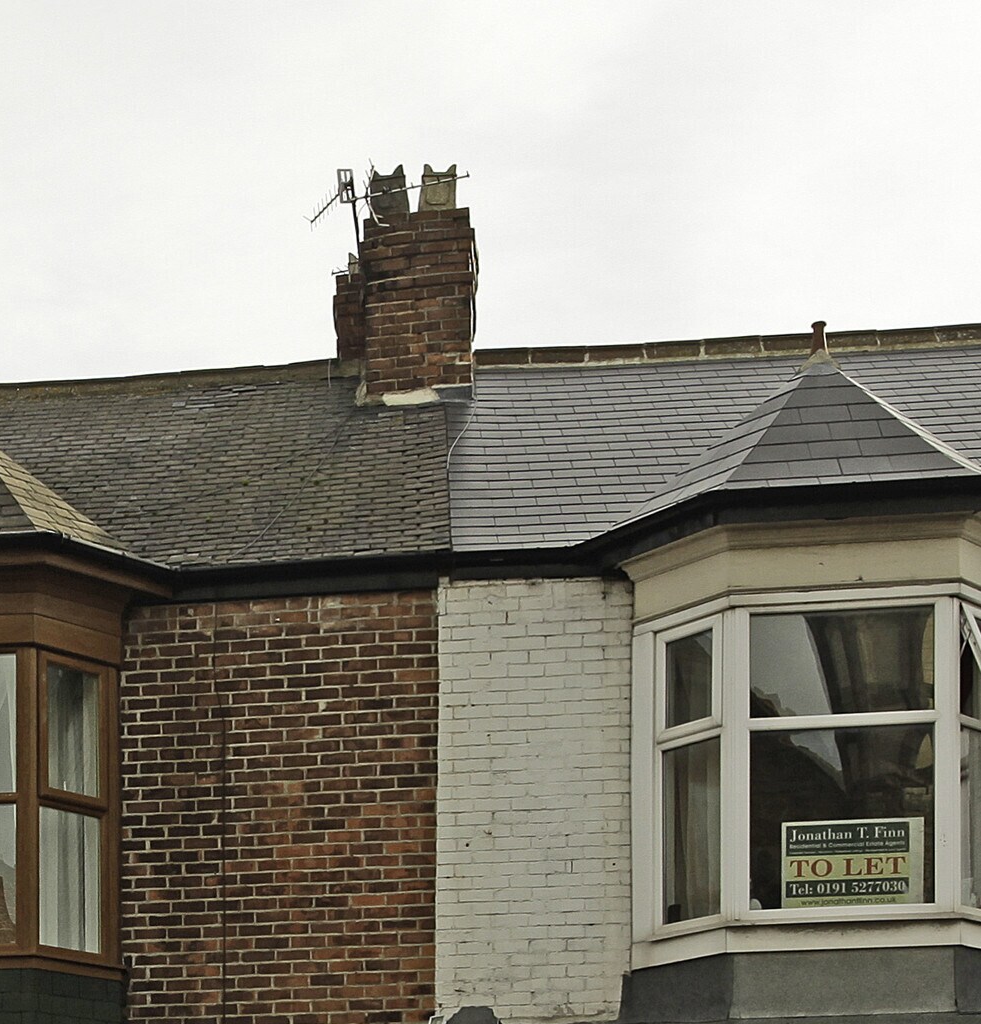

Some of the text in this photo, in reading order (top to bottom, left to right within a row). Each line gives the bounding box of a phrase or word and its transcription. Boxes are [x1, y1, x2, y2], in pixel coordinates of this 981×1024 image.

[789, 825, 905, 843] Jonathan T. Finn
[789, 842, 821, 850] Residential
[828, 840, 864, 849] Commercial
[885, 839, 906, 847] Agents
[789, 856, 906, 878] TO LET
[789, 880, 906, 896] Tel: 0191 5277030
